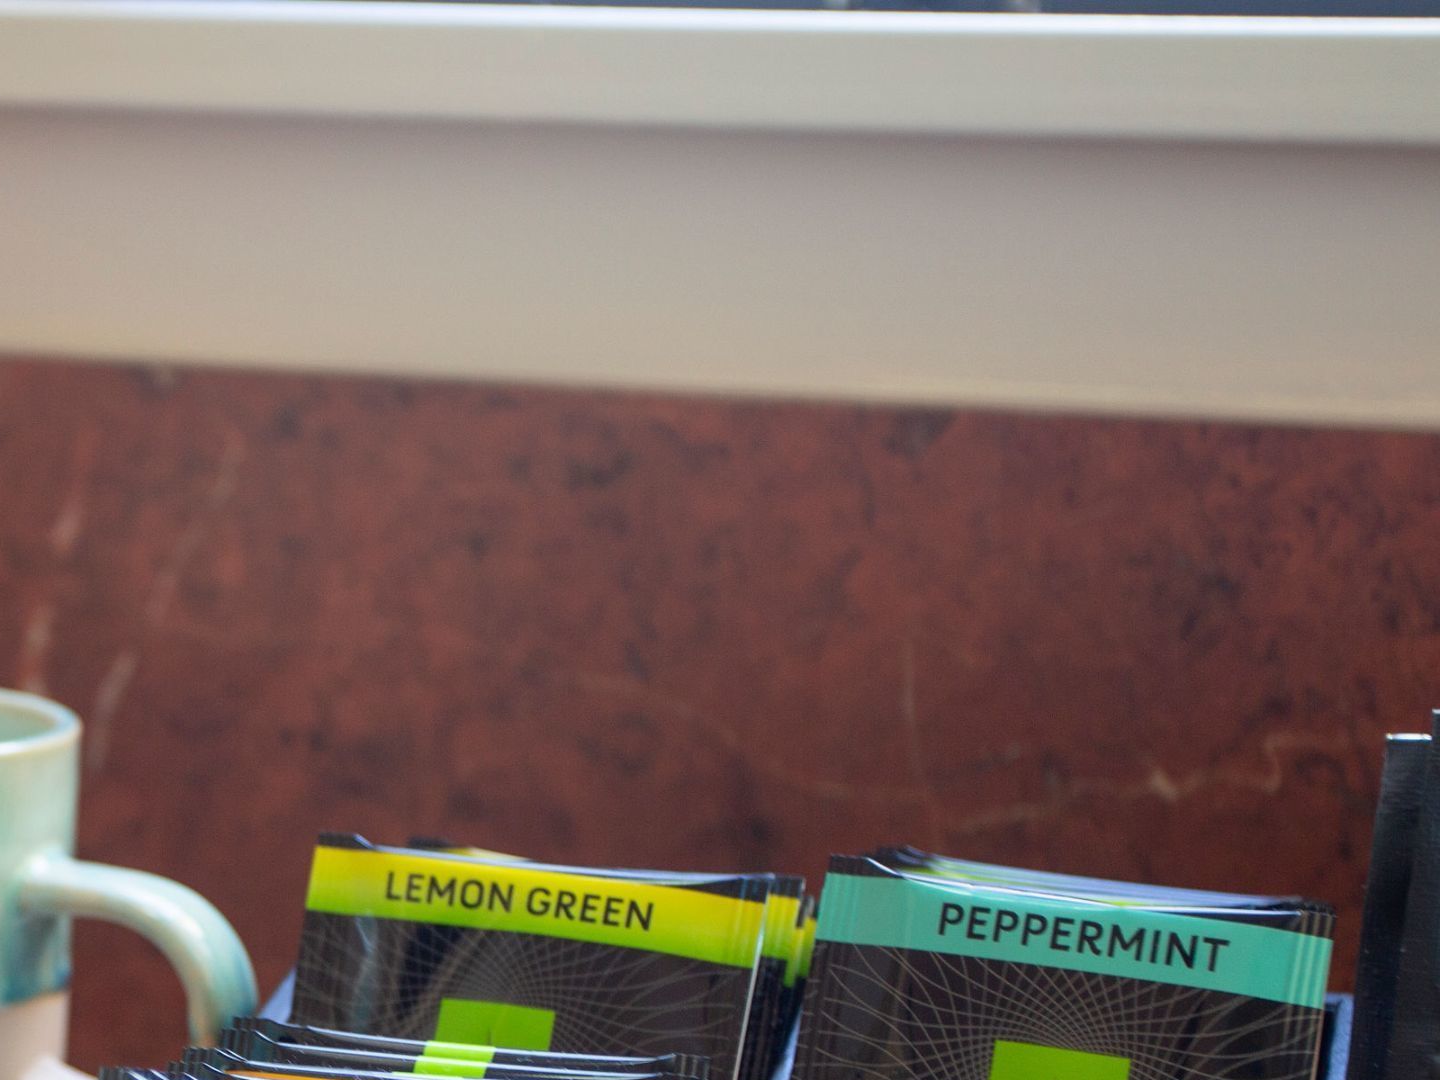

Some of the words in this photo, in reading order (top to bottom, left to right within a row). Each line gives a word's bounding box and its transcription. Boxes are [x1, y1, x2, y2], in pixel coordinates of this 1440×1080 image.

[386, 870, 514, 913] LEMON
[525, 886, 655, 932] GREEN
[937, 902, 1230, 973] PEPPERMINT
